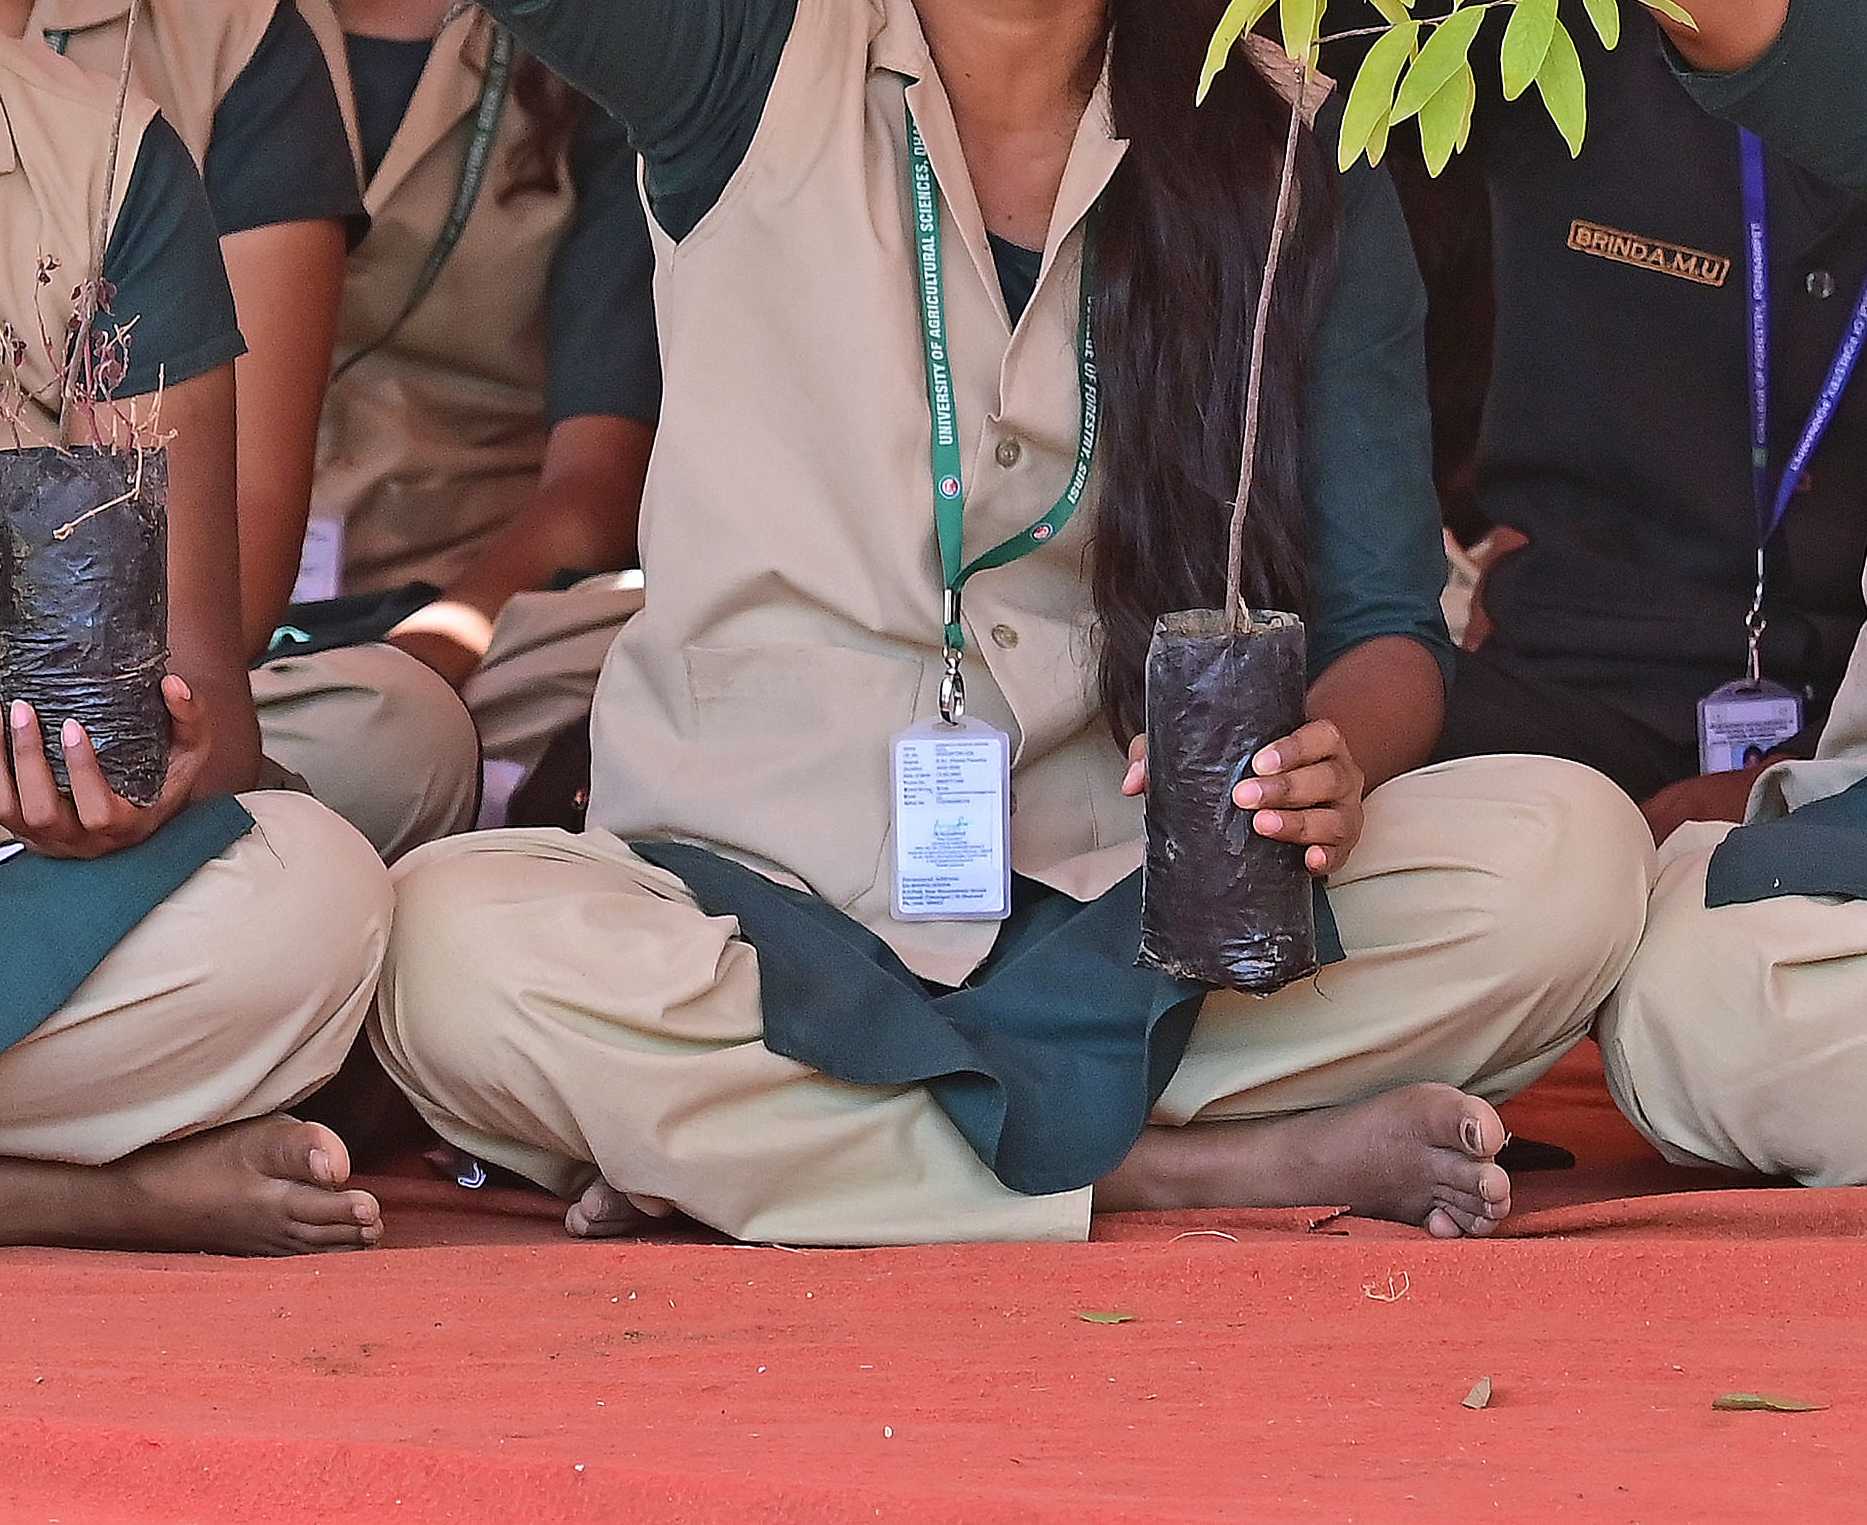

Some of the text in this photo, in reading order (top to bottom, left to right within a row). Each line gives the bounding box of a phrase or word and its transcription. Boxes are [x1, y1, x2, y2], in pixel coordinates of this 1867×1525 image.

[914, 158, 935, 234] SCIENCES,
[921, 234, 943, 339] AGRICULTURAL
[929, 340, 944, 361] OF
[932, 361, 954, 448] UNIVERSITY
[1079, 382, 1099, 461] FORESTRY,
[1066, 460, 1088, 506] SIRSI
